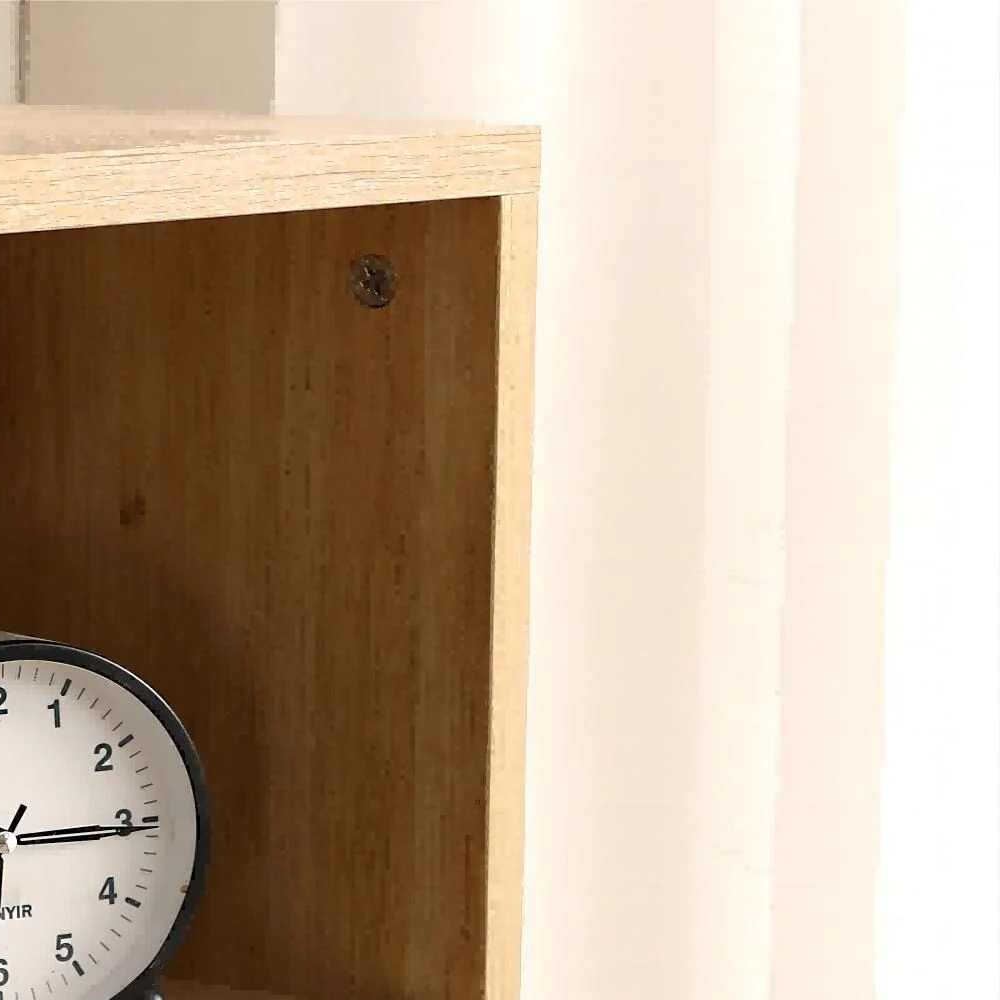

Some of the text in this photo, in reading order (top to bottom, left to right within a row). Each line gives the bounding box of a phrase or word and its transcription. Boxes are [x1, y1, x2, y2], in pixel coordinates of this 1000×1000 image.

[47, 699, 62, 728] 1
[93, 743, 114, 772] 2
[114, 808, 134, 837] 3
[98, 876, 118, 905] 4
[54, 933, 75, 962] 5
